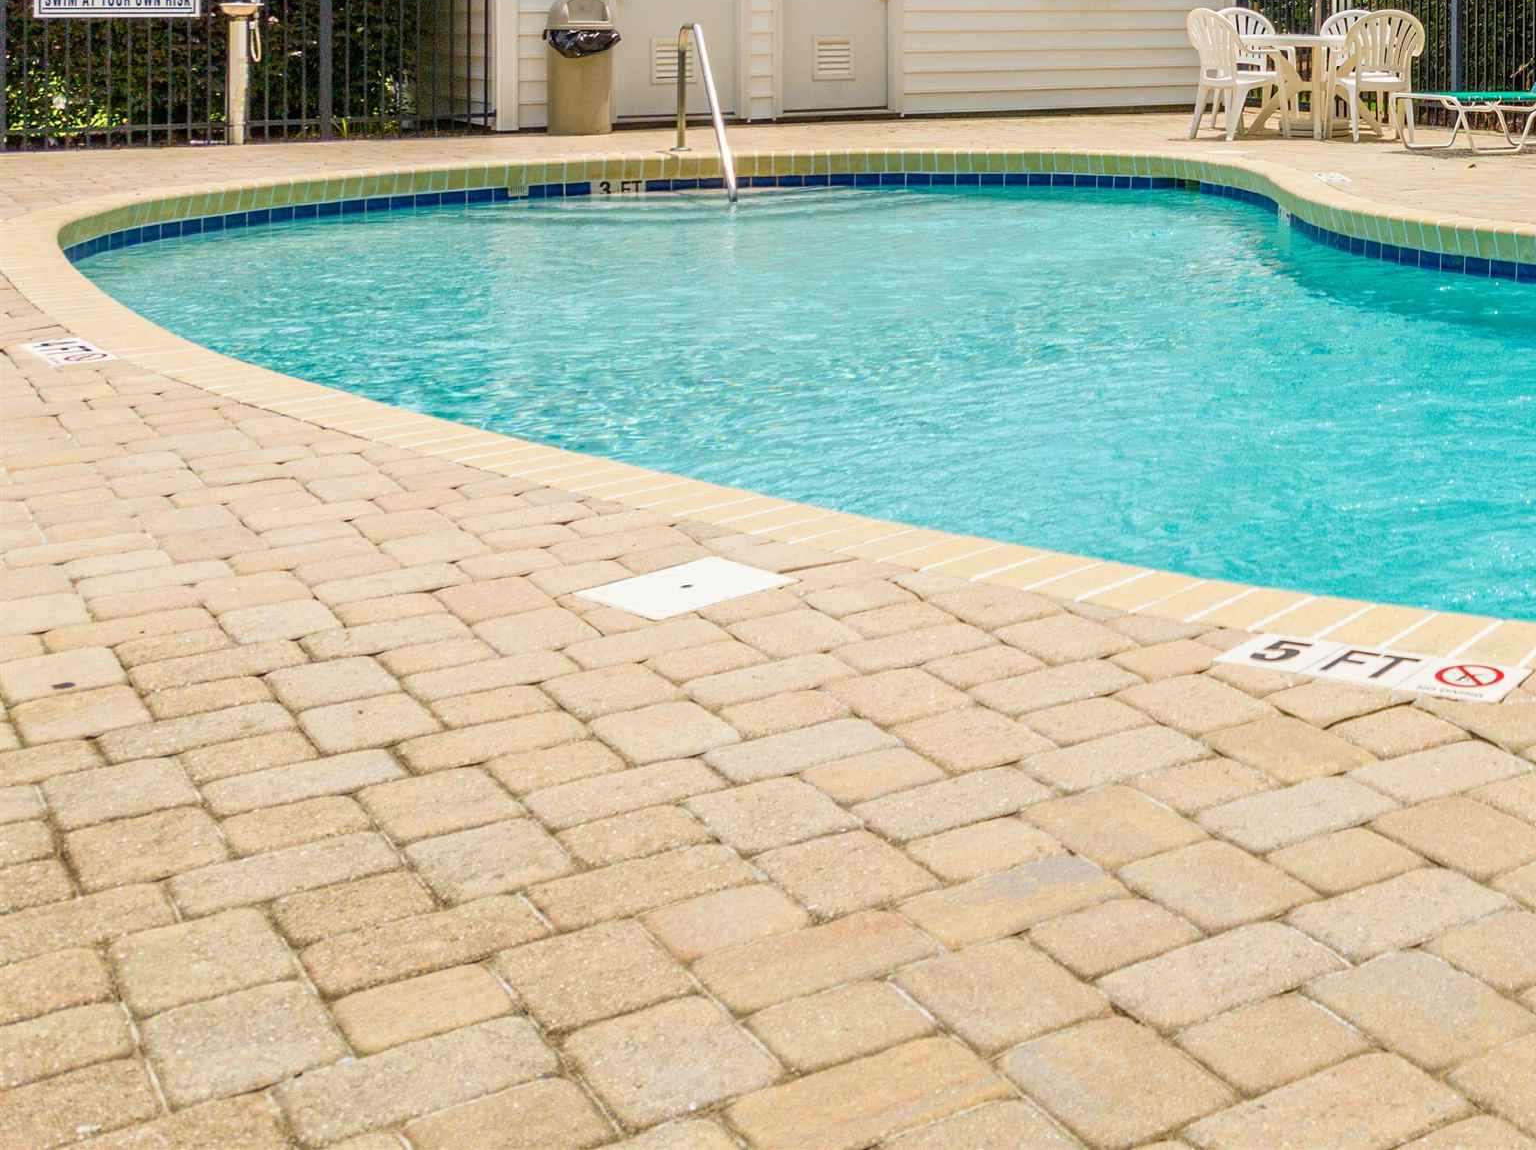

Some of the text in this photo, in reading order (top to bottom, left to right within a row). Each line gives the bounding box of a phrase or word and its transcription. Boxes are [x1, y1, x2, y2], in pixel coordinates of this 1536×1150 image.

[599, 180, 643, 195] 3 FT
[1250, 639, 1421, 679] 5 FT
